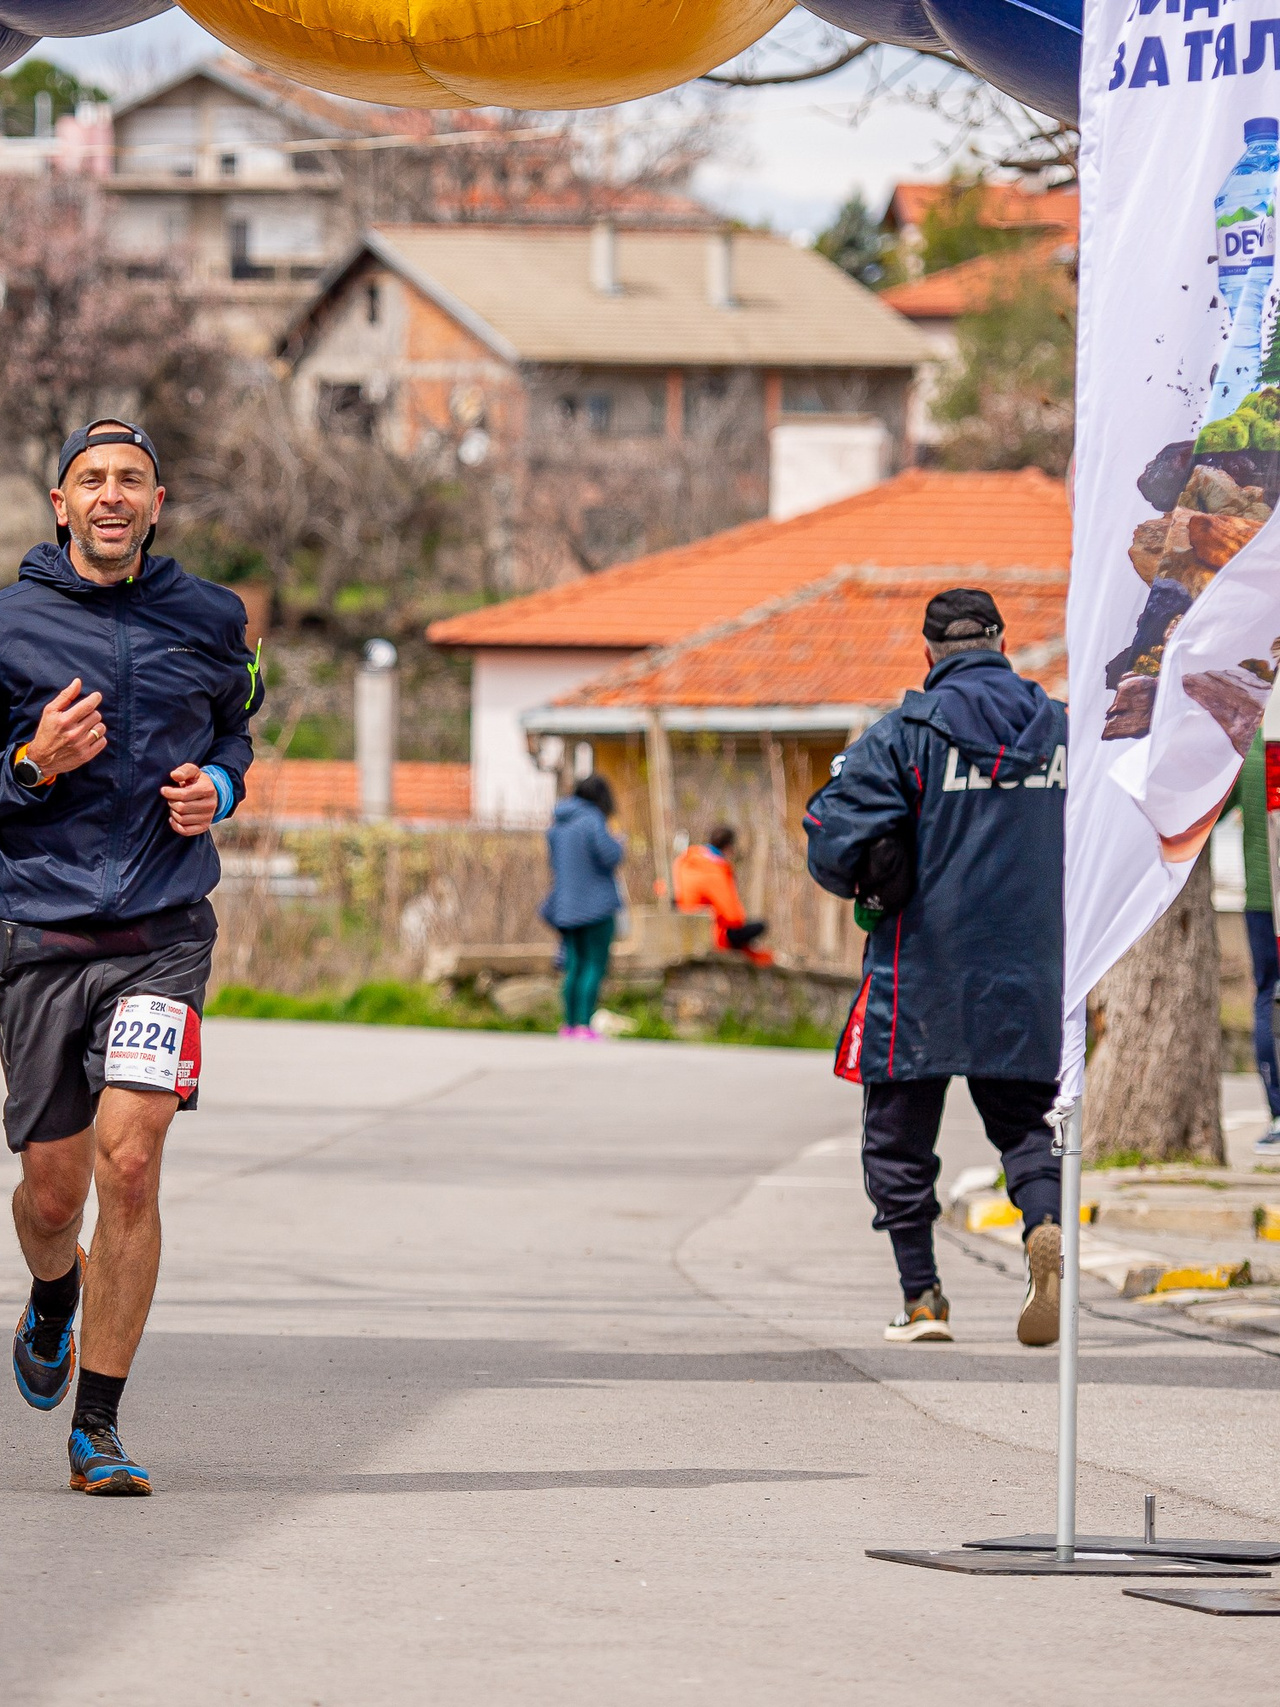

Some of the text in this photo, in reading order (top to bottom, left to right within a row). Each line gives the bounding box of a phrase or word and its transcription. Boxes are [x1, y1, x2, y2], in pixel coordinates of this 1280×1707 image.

[1109, 36, 1170, 91] ЗА
[111, 1020, 177, 1055] 2224
[109, 1050, 157, 1063] MARKOVO TRAIL
